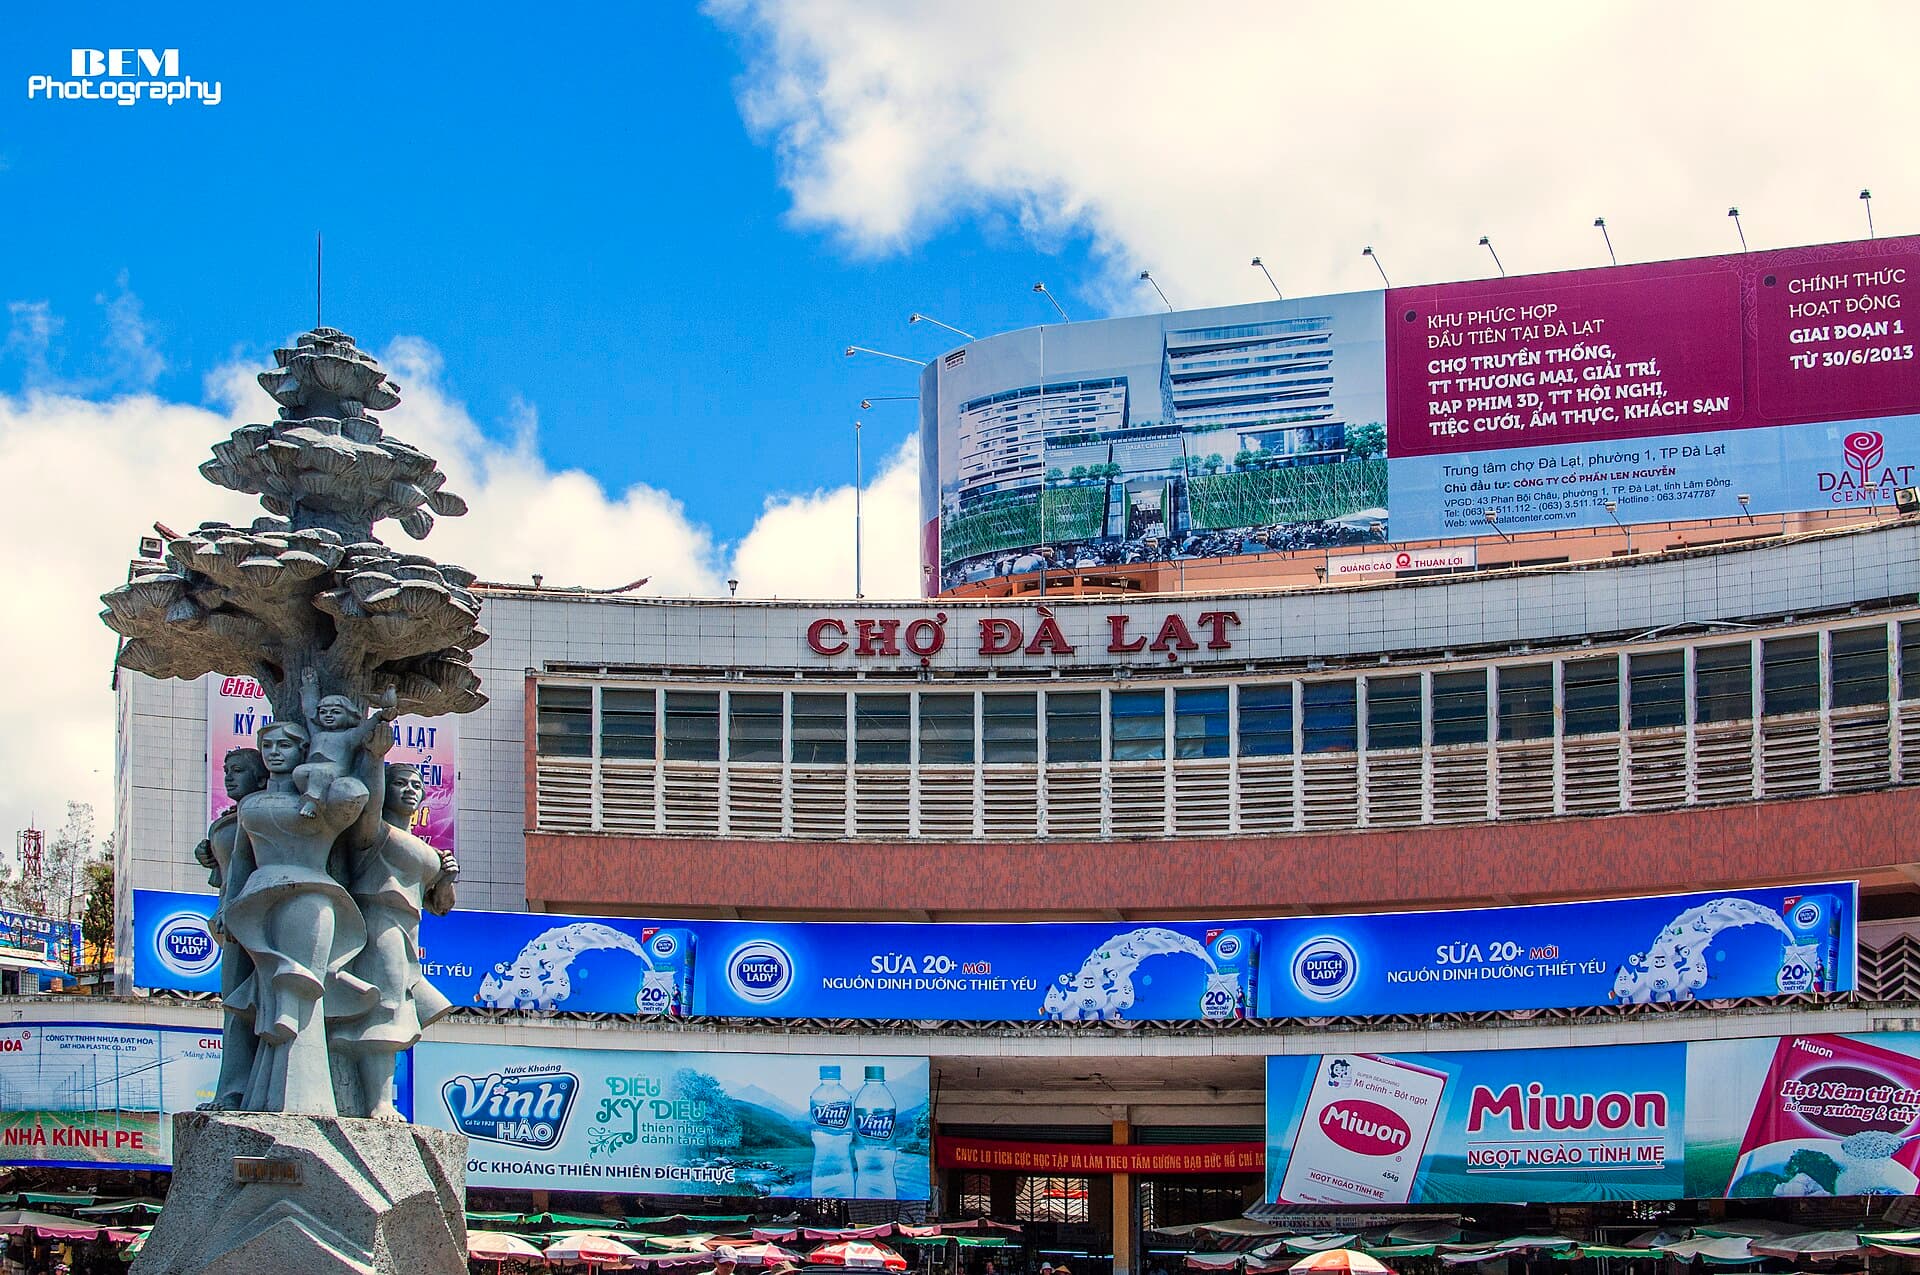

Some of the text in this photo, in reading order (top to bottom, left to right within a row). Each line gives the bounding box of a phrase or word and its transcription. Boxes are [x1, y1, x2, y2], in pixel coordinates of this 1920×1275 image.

[1788, 267, 1906, 294] CHÍNH THỨC
[1427, 303, 1558, 329] KHU PHỨC HỢP
[1789, 294, 1901, 318] HOẠT ĐỘNG
[1467, 327, 1506, 345] TIÊN
[1511, 325, 1539, 342] TẠI
[1543, 320, 1568, 337] ĐÀ
[1572, 319, 1604, 336] LẠT
[1789, 320, 1904, 344] GIAI ĐOẠN 1
[1428, 356, 1467, 375] CHỢ
[1789, 344, 1914, 370] TỪ 30/6/2013
[1428, 379, 1452, 396] TT
[1455, 371, 1535, 392] THƯƠNG
[1539, 367, 1579, 386] MẠI,
[1582, 360, 1622, 381] GIẢI
[1429, 381, 1668, 417] RẠP PHIM 3D, TT HỘI NGHỊ,
[1624, 399, 1689, 420] KHÁCH
[1693, 397, 1729, 415] SẠN
[1443, 465, 1479, 477] Trung
[1483, 462, 1506, 474] tâm
[1510, 460, 1535, 473] chợ
[1659, 447, 1679, 459] TP
[1546, 476, 1559, 485] TY
[1610, 471, 1630, 481] LEN
[1477, 496, 1489, 505] 43
[1491, 495, 1514, 504] Phan
[1657, 489, 1717, 502] 063.3747787
[806, 606, 1241, 667] CHỢ ĐÀ LẠT
[233, 707, 256, 736] KỶ
[407, 725, 437, 753] LẠT
[171, 935, 208, 947] DUTCH
[175, 944, 204, 955] LADY
[871, 951, 992, 976] SỮA 20+ MỚI
[1436, 941, 1558, 965] SỮA 20+ MỚI
[742, 963, 778, 975] DUTCH
[1306, 959, 1343, 971] DUTCH
[1311, 968, 1339, 980] LADY
[1443, 967, 1478, 981] DINH
[1782, 964, 1809, 980] 20+
[746, 972, 775, 983] LADY
[877, 976, 913, 991] DINH
[641, 987, 668, 1002] 20+
[1205, 991, 1232, 1006] 20+
[1792, 1038, 1833, 1058] Miwon
[504, 1063, 562, 1074] Nước Khoáng
[455, 1074, 563, 1119] Vĩnh
[1781, 1079, 1818, 1100] Hạt
[1819, 1082, 1864, 1101] Nêm
[1467, 1081, 1667, 1132] Miwon
[1798, 1103, 1822, 1115] sung
[1824, 1104, 1874, 1122] xương
[1875, 1105, 1888, 1121] &
[1323, 1105, 1407, 1146] Miwon
[5, 1124, 144, 1150] NHÀ KÍNH PE
[955, 1147, 978, 1162] CNVC
[1084, 1152, 1103, 1169] LÀM
[1106, 1155, 1128, 1169] THEO
[1468, 1143, 1665, 1169] NGỌT NGÀO TÌNH MẸ
[491, 1160, 736, 1185] KHOÁNG THIÊN NHIÊN ĐÍCH THỰC
[1382, 1171, 1399, 1183] 454g
